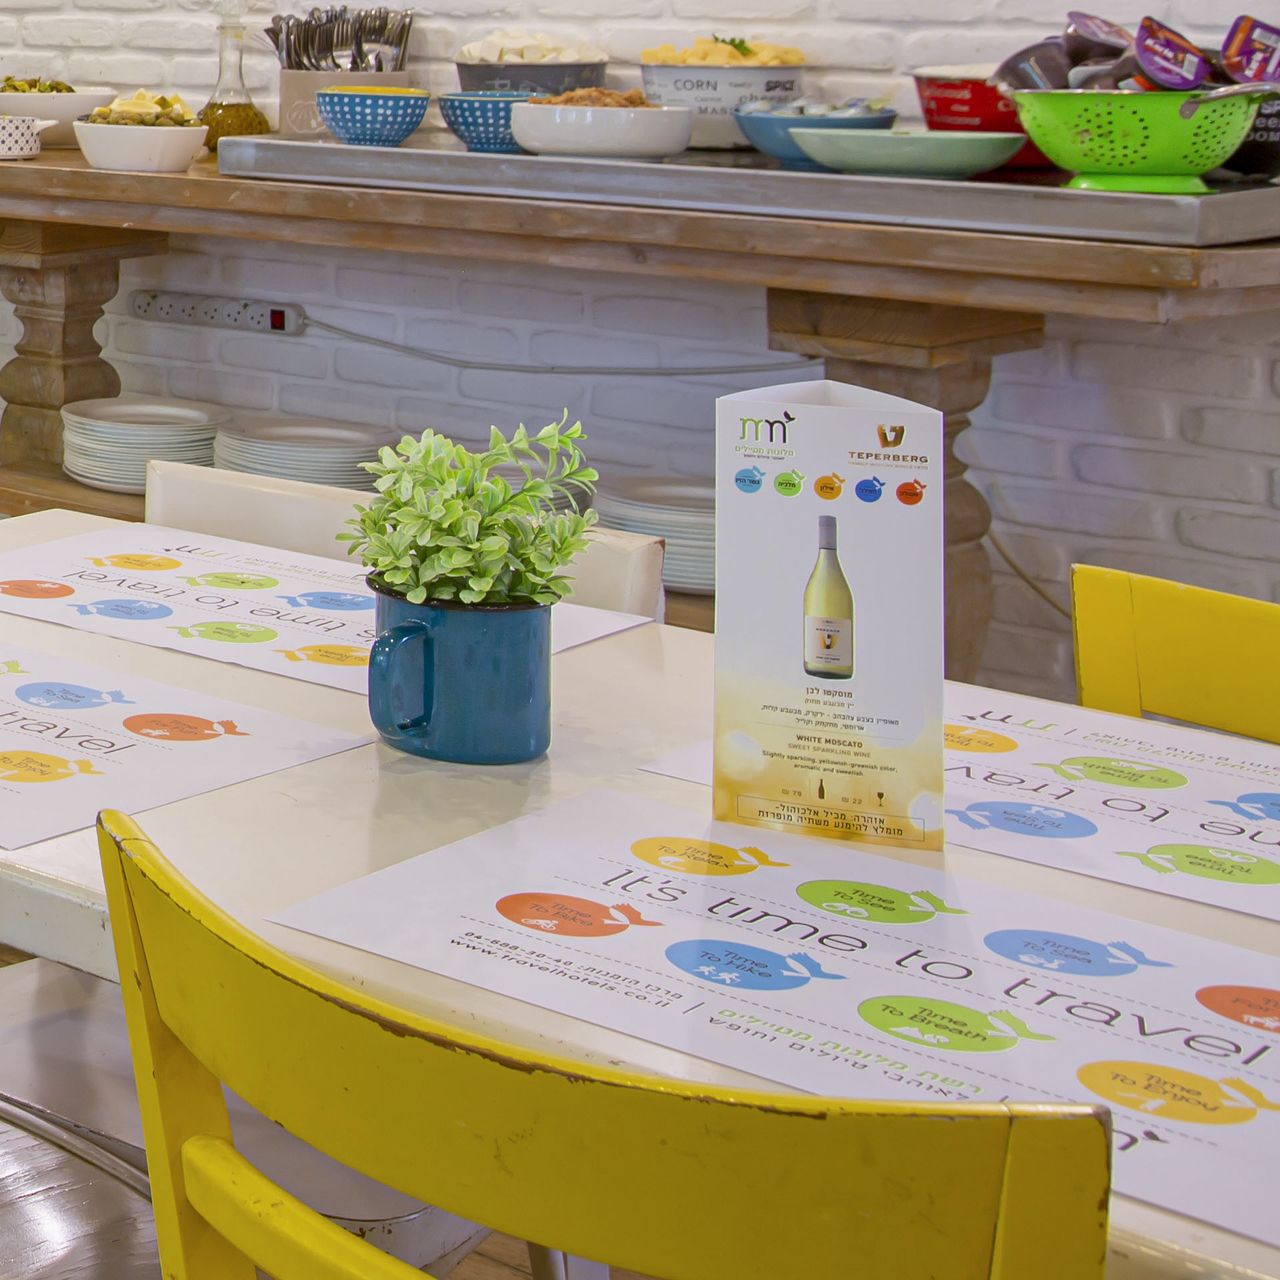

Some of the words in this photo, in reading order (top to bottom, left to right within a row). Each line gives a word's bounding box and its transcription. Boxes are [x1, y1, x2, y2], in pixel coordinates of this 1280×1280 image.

[673, 79, 718, 92] CORN
[848, 451, 929, 463] TEPERBERG
[62, 568, 188, 602] travel
[195, 593, 241, 612] to
[249, 606, 350, 634] time
[806, 686, 820, 695] לבן
[823, 689, 853, 699] מוסקטו
[788, 743, 810, 751] SWEET
[812, 746, 852, 756] SPARKLING
[853, 751, 871, 759] WINE
[796, 734, 822, 744] WHITE
[824, 738, 863, 749] MOSCATO
[762, 750, 785, 759] Slightly
[794, 763, 820, 771] aromatic
[944, 764, 1075, 801] trav
[823, 809, 847, 820] מכיל
[1102, 797, 1170, 823] to
[796, 816, 830, 827] משתיה
[834, 819, 868, 832] להימנע
[872, 825, 903, 836] מומלץ
[657, 845, 678, 855] To
[677, 850, 733, 870] Relax
[686, 846, 724, 860] Time
[833, 890, 854, 901] To
[852, 888, 895, 904] Time
[528, 903, 550, 914] To
[552, 910, 593, 927] Bike
[552, 902, 592, 918] Time
[464, 931, 574, 967] 04-688-30-40
[1023, 940, 1048, 952] To
[1041, 938, 1092, 956] Time
[602, 868, 688, 903] It's
[707, 897, 868, 952] time
[895, 949, 974, 980] to
[1003, 977, 1272, 1066] travel
[699, 951, 721, 963] To
[722, 961, 773, 979] Hike
[724, 950, 769, 970] Time
[450, 938, 671, 1010] www.travelhotels.co.il
[645, 983, 683, 1000] מרכז
[717, 1008, 815, 1043] מטיילים
[880, 1004, 905, 1017] To
[908, 1015, 988, 1043] Breath
[917, 1006, 969, 1028] Time
[708, 1016, 778, 1044] וחופש
[788, 1041, 870, 1073] טיולים
[819, 1040, 910, 1072] מלונות
[883, 1069, 971, 1103] לאוהבי
[917, 1070, 984, 1096] רשת
[1110, 1072, 1136, 1087] To
[1141, 1082, 1221, 1114] Enjoy
[1145, 1072, 1203, 1098] Time
